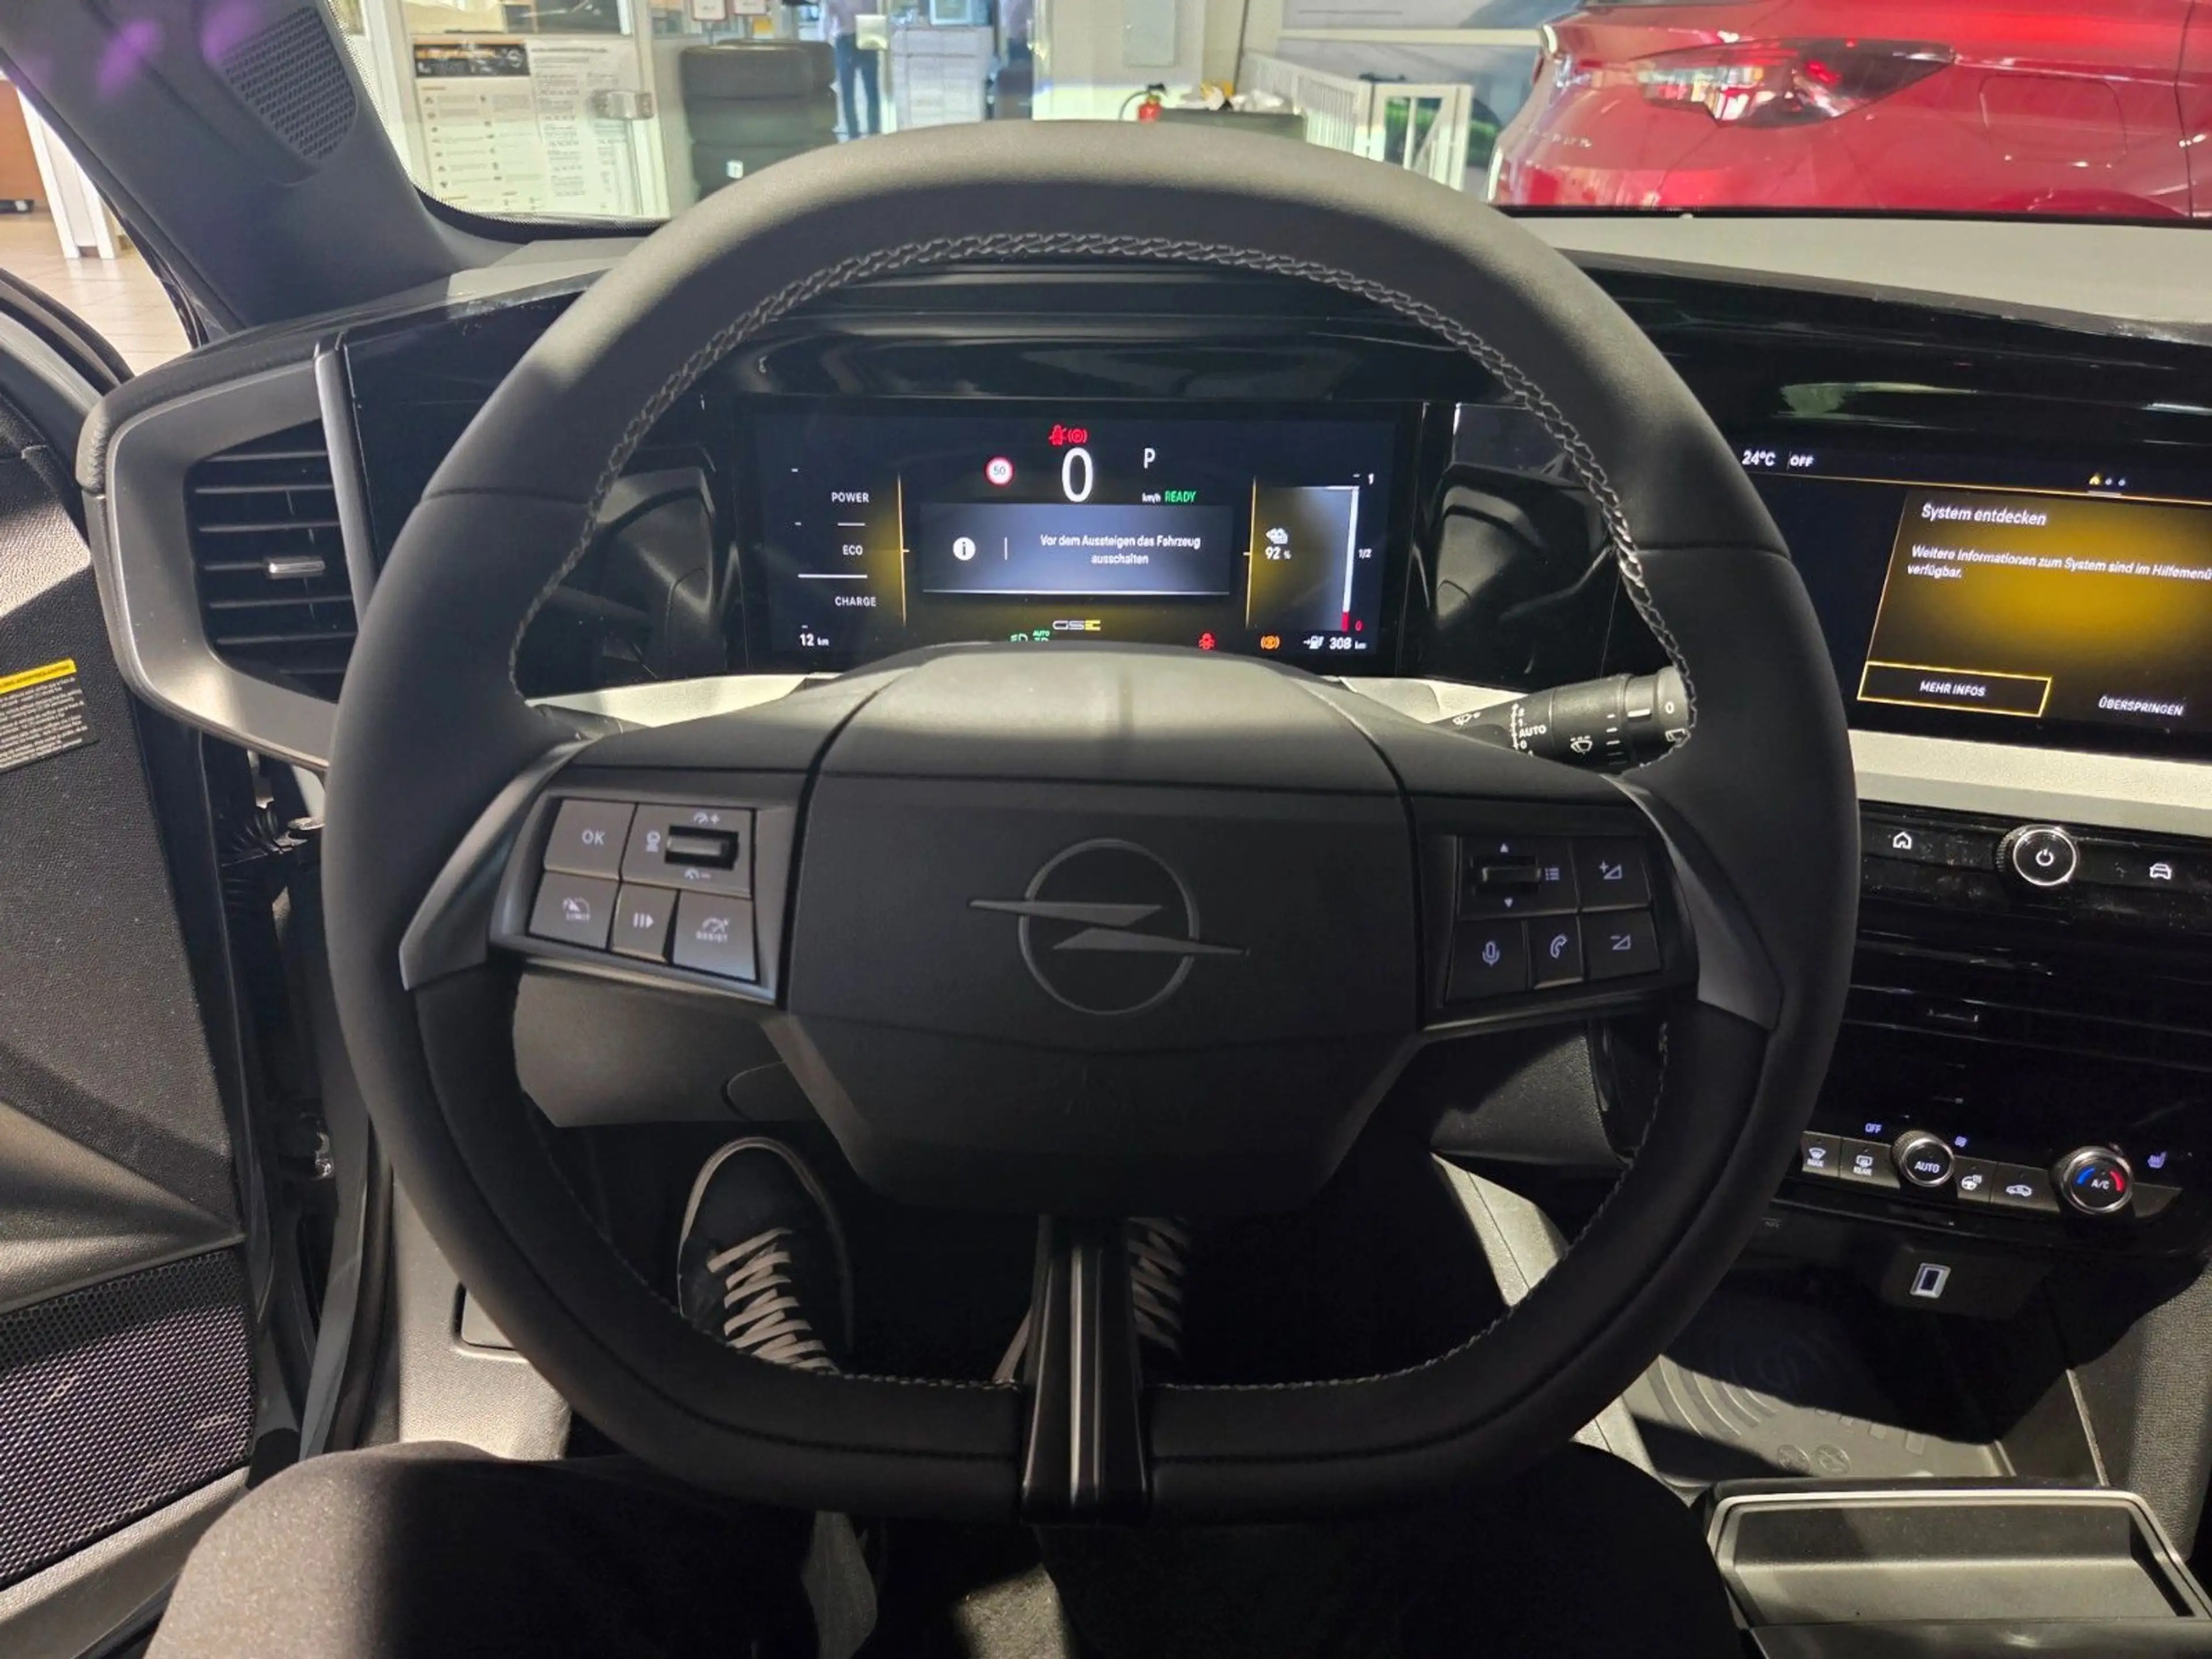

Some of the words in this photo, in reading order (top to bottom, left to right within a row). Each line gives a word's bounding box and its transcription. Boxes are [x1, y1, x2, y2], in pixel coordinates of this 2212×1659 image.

[1143, 448, 1156, 469] P
[1742, 450, 1776, 466] 24°C
[1790, 455, 1814, 467] OFF
[993, 465, 1006, 475] 50
[1062, 447, 1093, 502] 0
[831, 492, 869, 503] POWER
[1165, 490, 1196, 503] READY
[1921, 502, 1971, 522] System
[1974, 507, 2047, 526] entdecken
[1040, 535, 1056, 546] Vor
[1059, 535, 1080, 546] dem
[1082, 535, 1135, 548] Aussteigen
[1137, 535, 1153, 547] das
[1157, 535, 1200, 550] Fahrzeug
[842, 545, 863, 555] ECO
[1265, 547, 1281, 559] 92
[1091, 553, 1149, 565] ausschalten
[1912, 544, 1956, 560] Weitere
[1957, 549, 2036, 566] Informationen
[2038, 556, 2062, 569] zum
[2064, 557, 2107, 572] System
[2108, 561, 2134, 574] sind
[2135, 563, 2150, 575] im
[1907, 564, 1962, 579] verfügbar.
[835, 596, 876, 607] CHARGE
[800, 633, 814, 646] 12
[1330, 637, 1352, 650] 308
[1355, 641, 1367, 650] km
[1920, 681, 1951, 695] MEHR
[1952, 685, 1986, 696] INFOS
[2098, 695, 2183, 716] ÜBERSPRINGEN
[1519, 724, 1547, 738] AUTO
[582, 828, 605, 845] OK
[1865, 1123, 1881, 1133] OFF
[1915, 1161, 1940, 1173] AUTO
[2091, 1179, 2109, 1190] A/C
